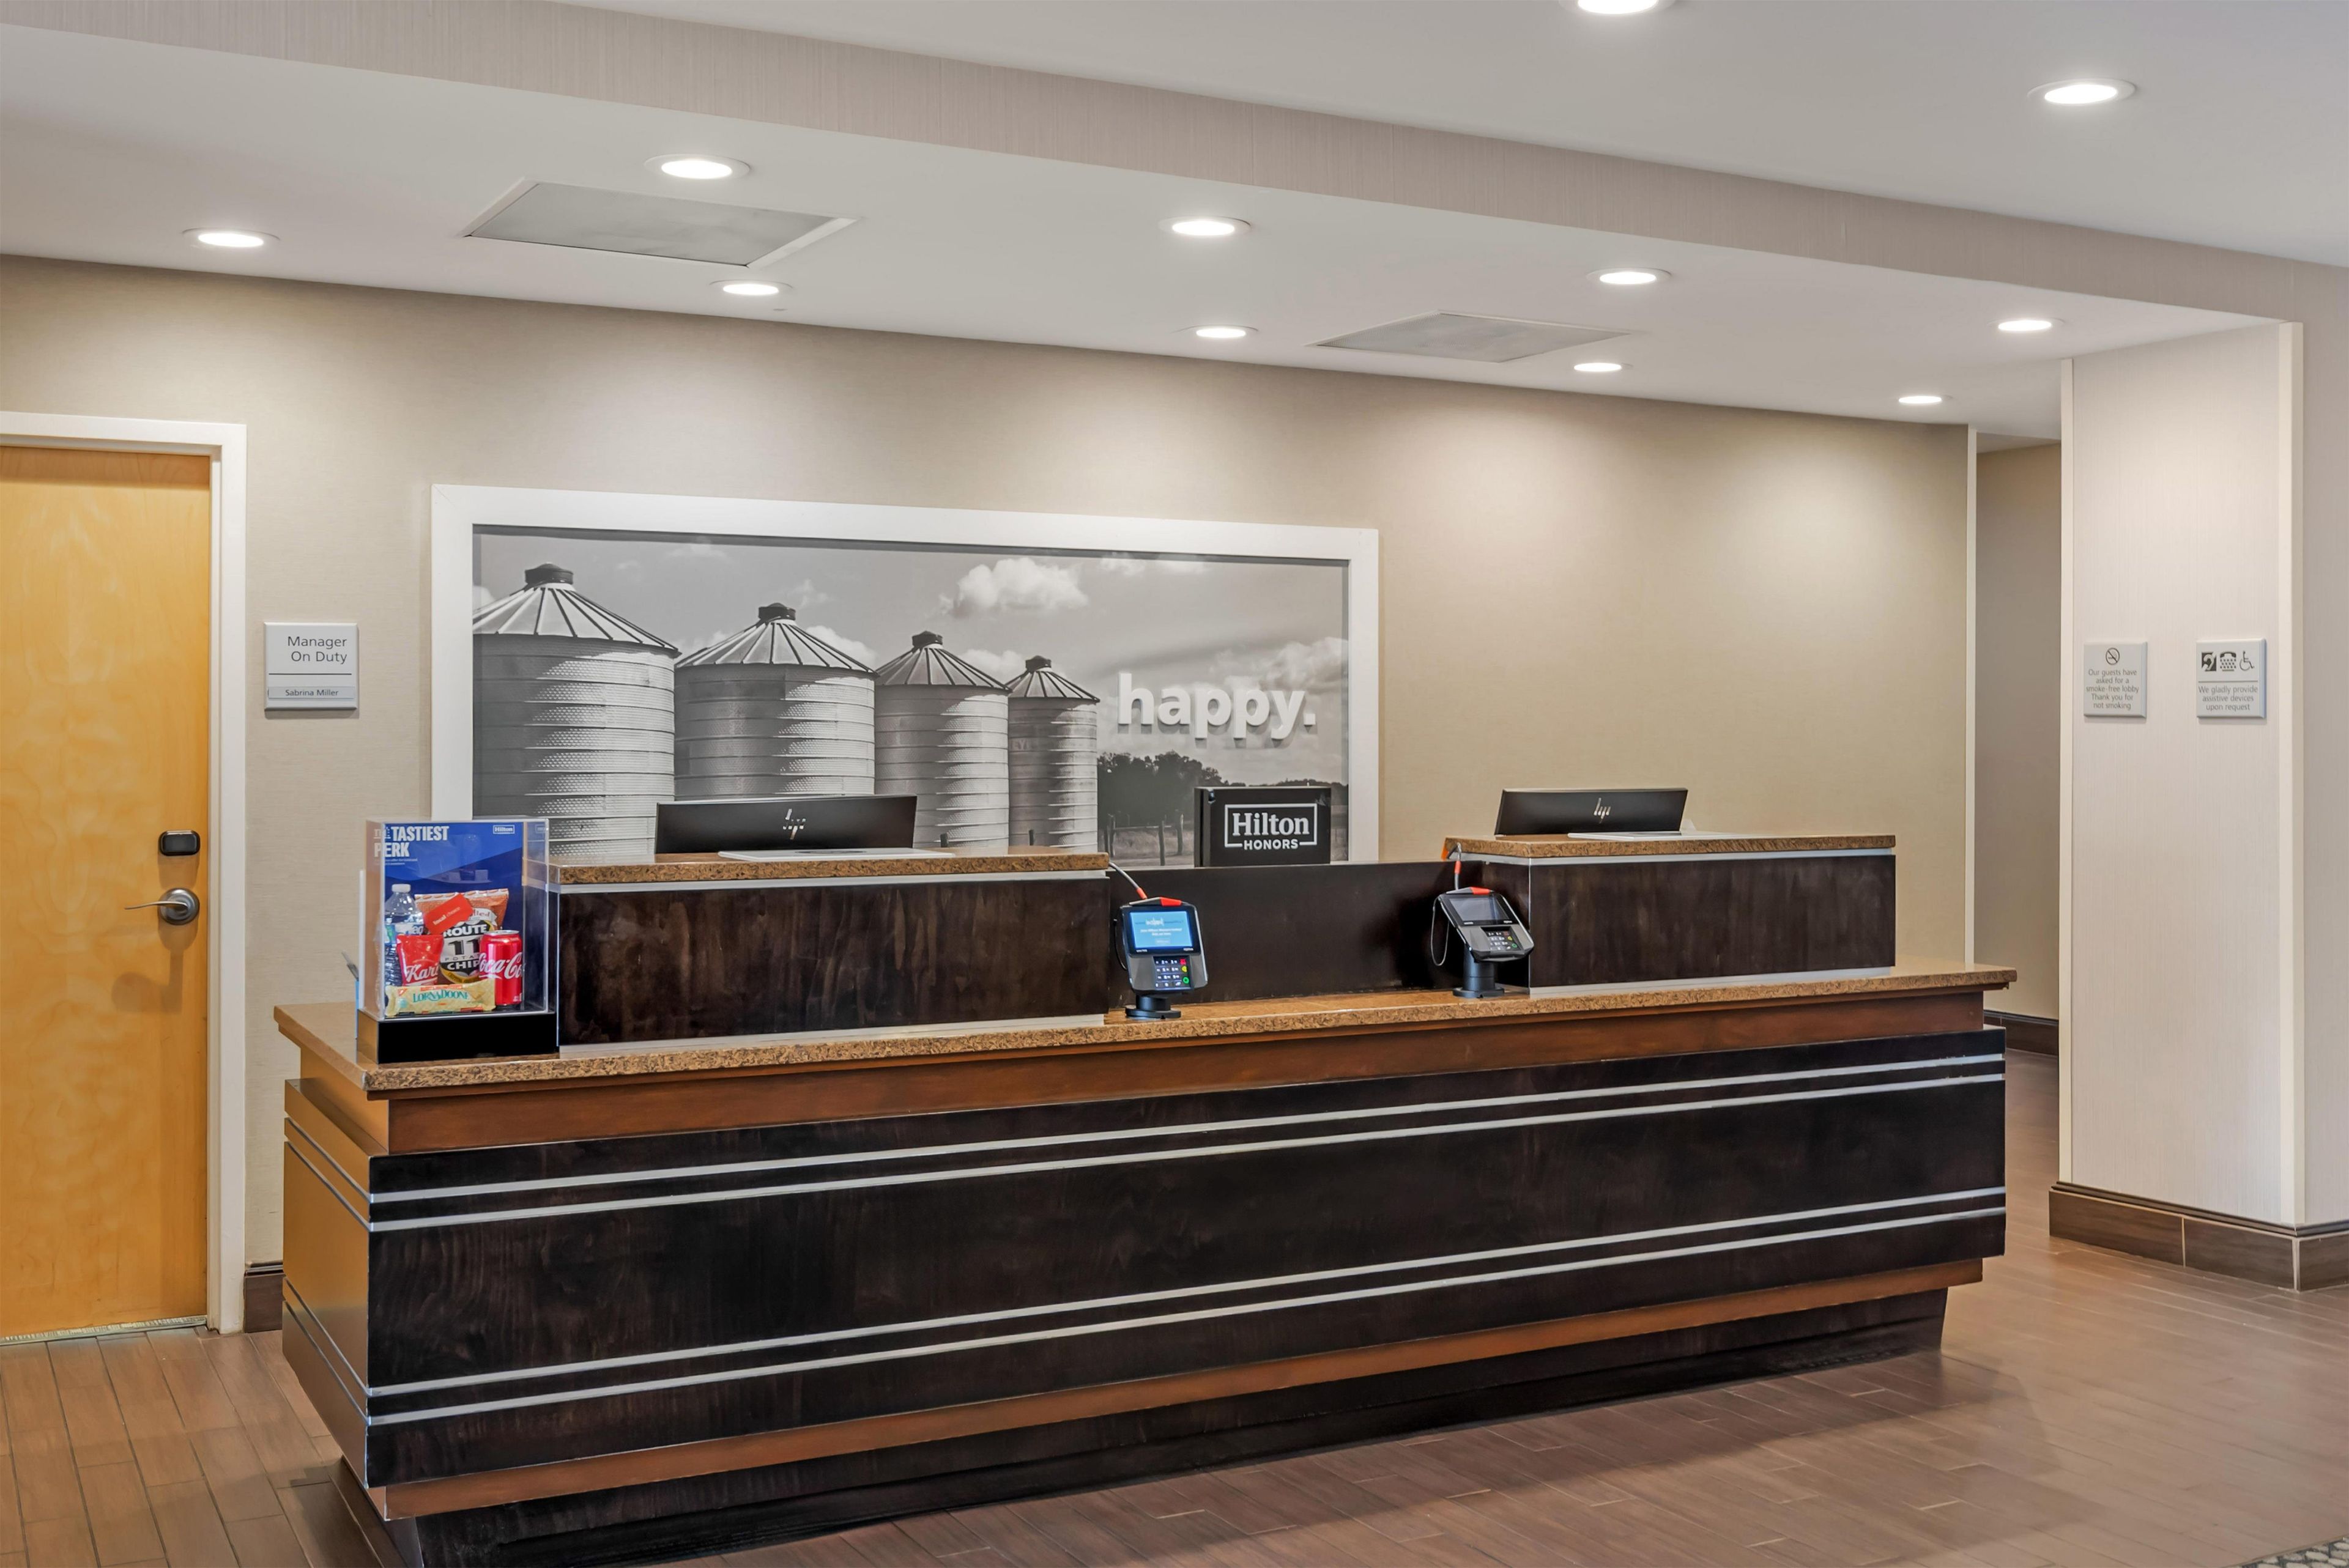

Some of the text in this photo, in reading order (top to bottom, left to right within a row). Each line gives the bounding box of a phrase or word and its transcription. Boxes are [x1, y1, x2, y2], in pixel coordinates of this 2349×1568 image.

[288, 636, 347, 649] Manager
[291, 651, 347, 664] On Duty
[2121, 685, 2139, 693] lobby
[2233, 686, 2258, 695] provide
[1118, 673, 1316, 740] happy.
[2106, 702, 2131, 711] smoking
[1232, 812, 1310, 837] Hilton
[391, 826, 450, 841] TASTIEST
[374, 842, 410, 857] PERK
[1244, 839, 1299, 851] HONORS
[443, 924, 488, 937] ROUTE
[448, 939, 480, 955] 11
[447, 960, 480, 970] CHIP
